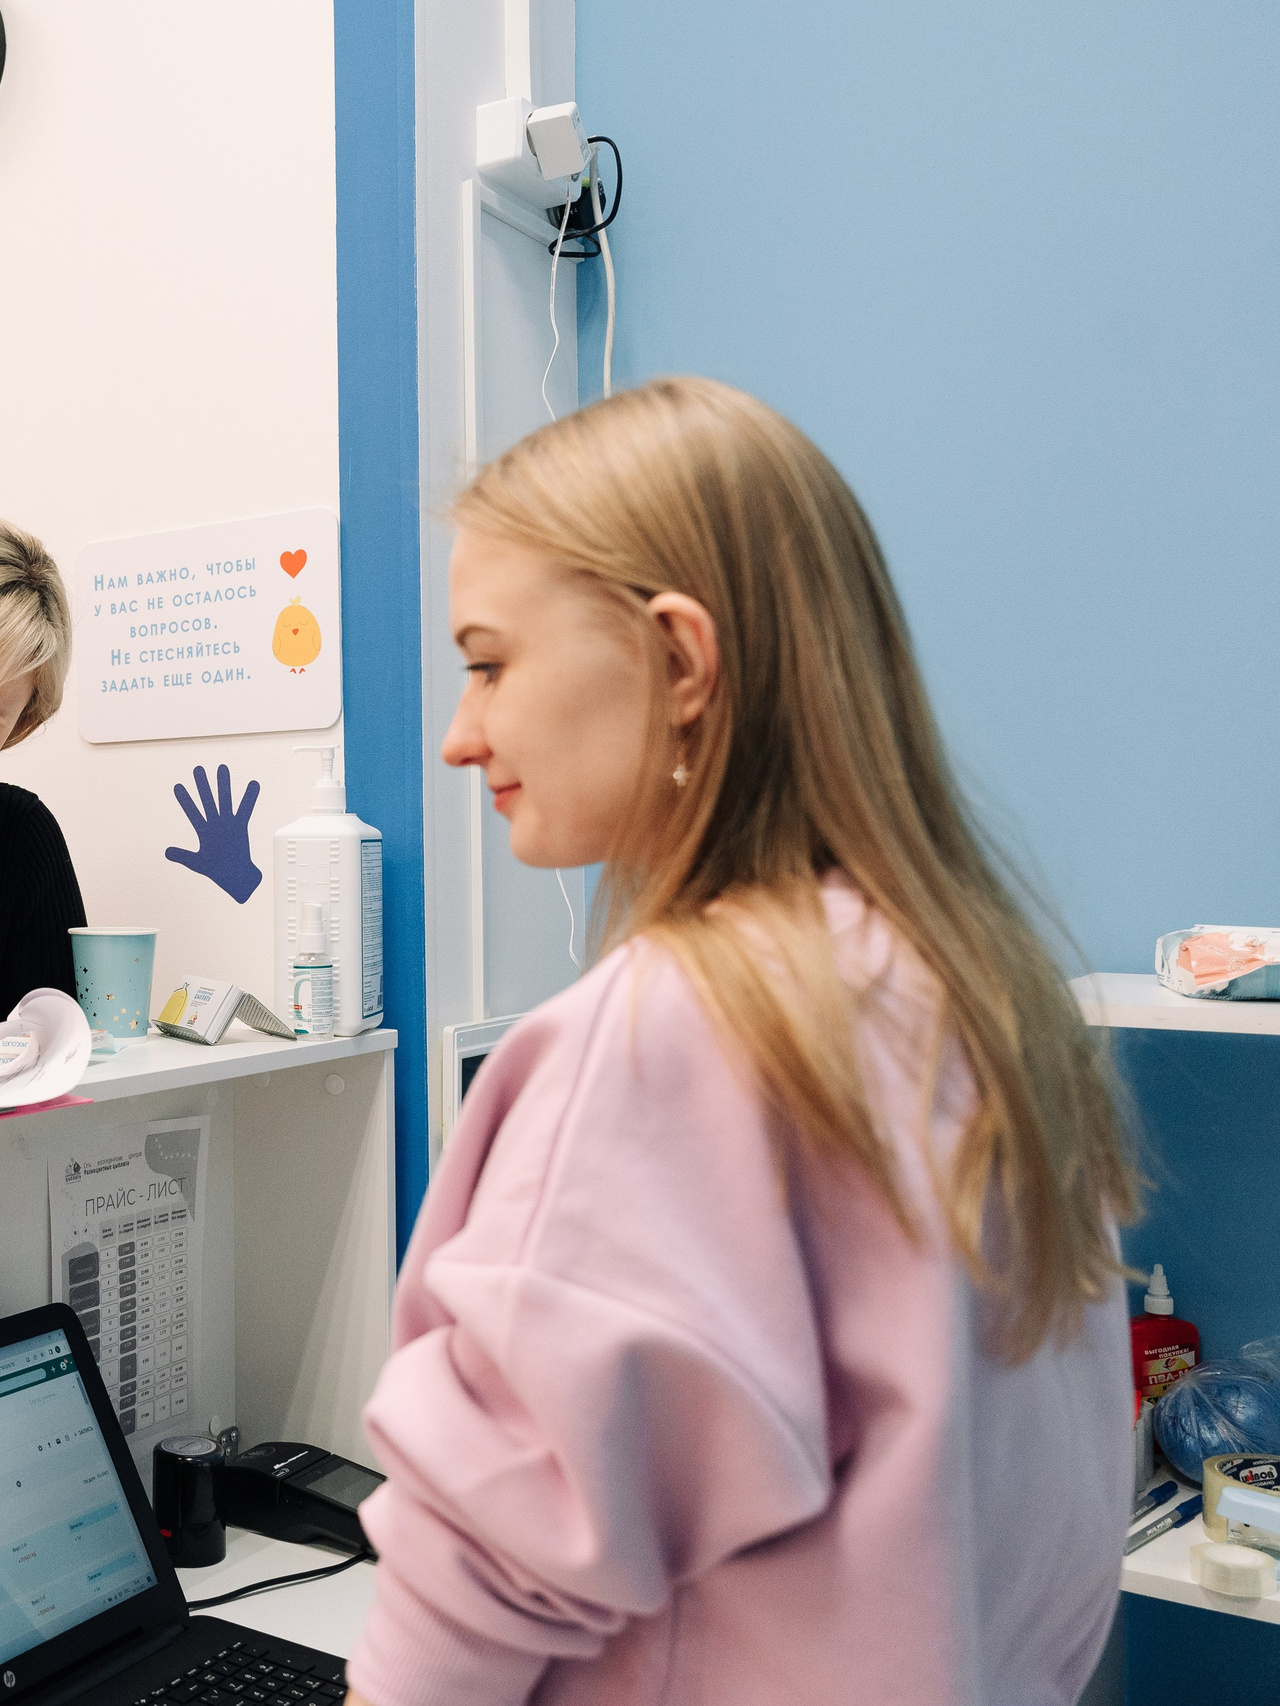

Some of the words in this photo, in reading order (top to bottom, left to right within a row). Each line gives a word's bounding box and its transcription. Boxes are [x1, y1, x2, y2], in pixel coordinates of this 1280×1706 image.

[85, 1188, 136, 1216] ПРАЙС
[147, 1177, 186, 1201] ЛИСТ
[1144, 1345, 1179, 1356] ВЫГОДНАЯ
[1158, 1348, 1189, 1359] ПОКУПКА!
